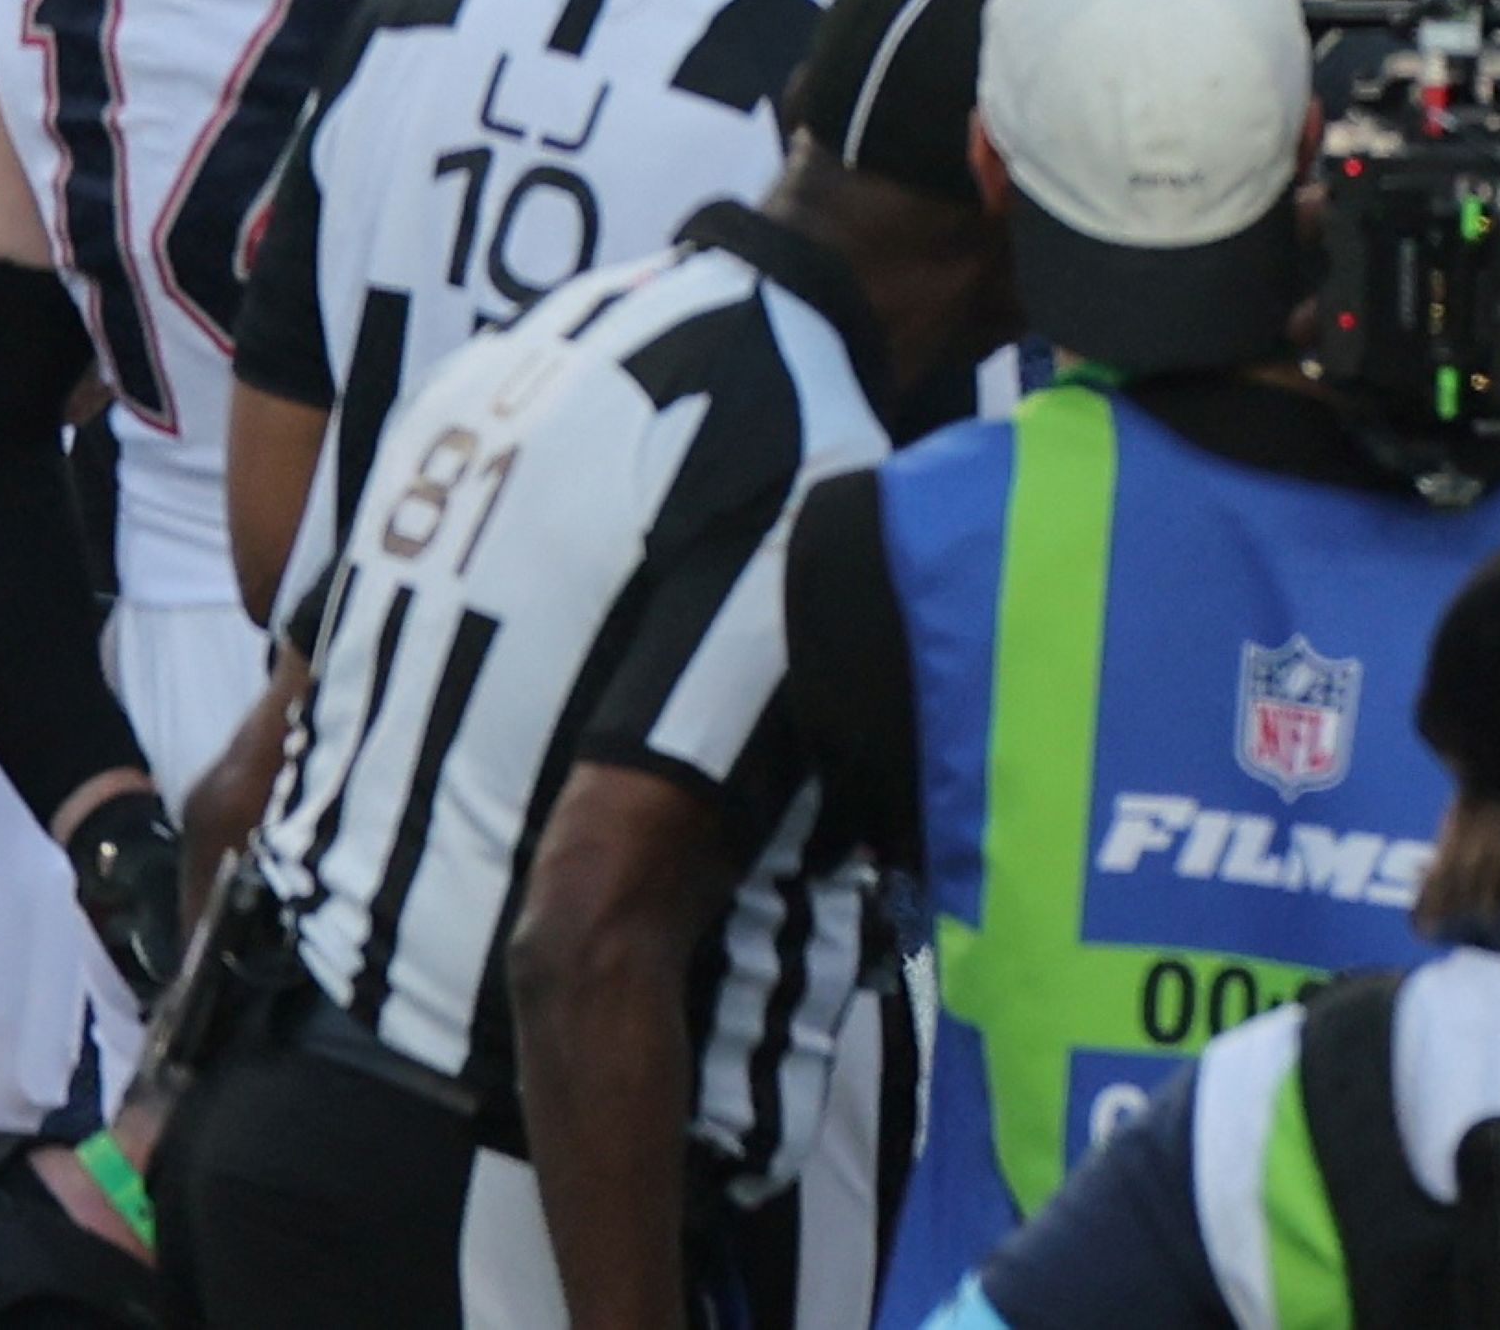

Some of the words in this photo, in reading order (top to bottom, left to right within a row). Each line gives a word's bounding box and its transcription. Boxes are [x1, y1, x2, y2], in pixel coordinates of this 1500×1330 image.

[480, 51, 610, 152] LJ
[433, 146, 600, 306] 10
[381, 426, 520, 579] 81
[1256, 705, 1336, 773] NFL
[1098, 793, 1437, 910] FILMS
